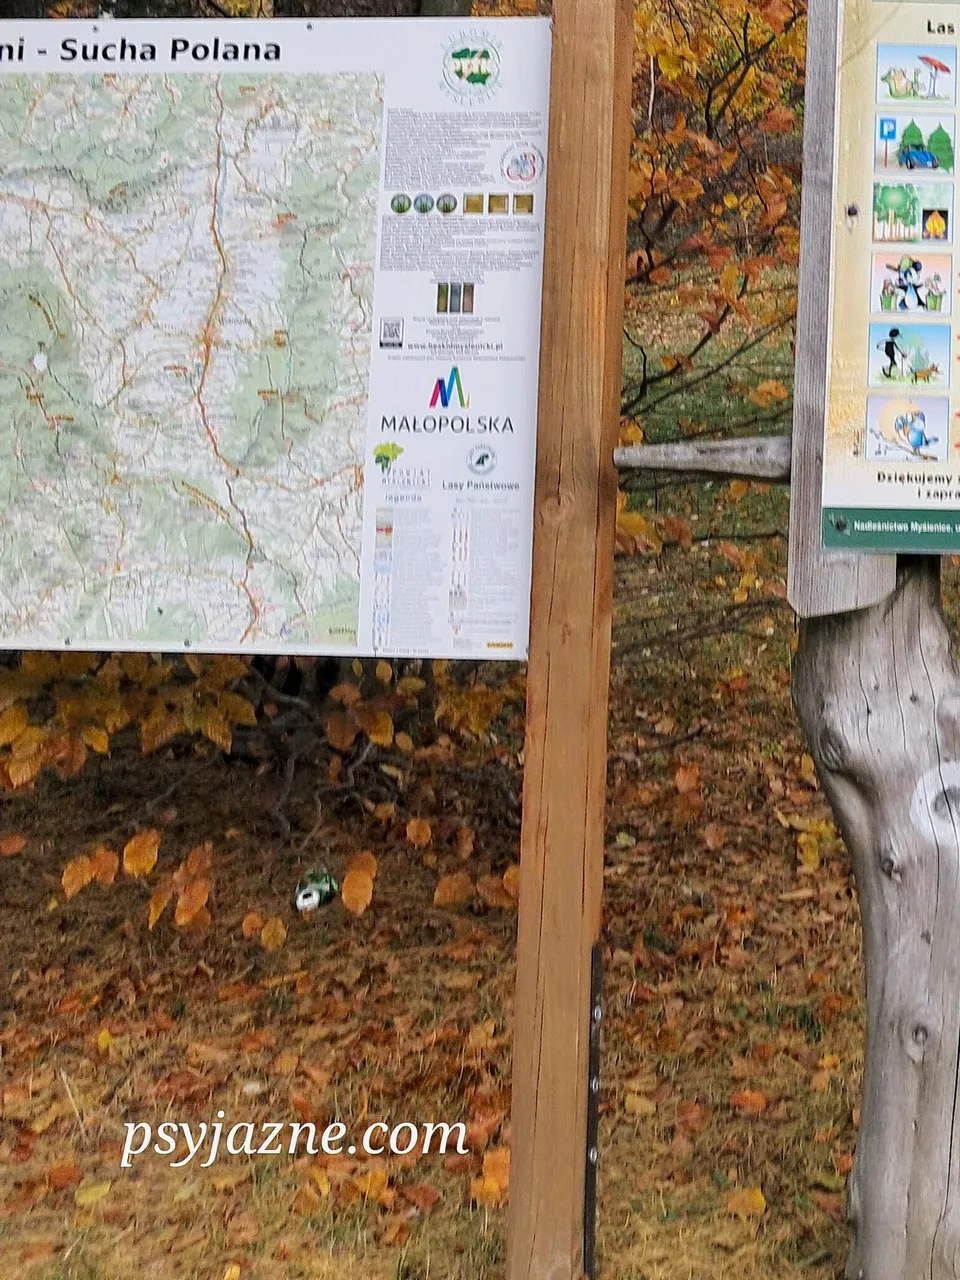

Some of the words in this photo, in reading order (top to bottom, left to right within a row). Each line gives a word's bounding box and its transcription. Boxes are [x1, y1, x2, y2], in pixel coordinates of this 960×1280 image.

[927, 20, 955, 34] Las
[60, 37, 156, 61] Sucha
[170, 37, 281, 61] Polana
[380, 415, 515, 434] MAŁOPOLSKA
[877, 470, 953, 486] Dziękujemy
[442, 480, 464, 493] Lasy
[466, 480, 520, 491] Państwowe
[385, 493, 422, 503] legenda
[853, 520, 908, 533] Nadleśnictwo
[910, 521, 954, 534] Myślenice,
